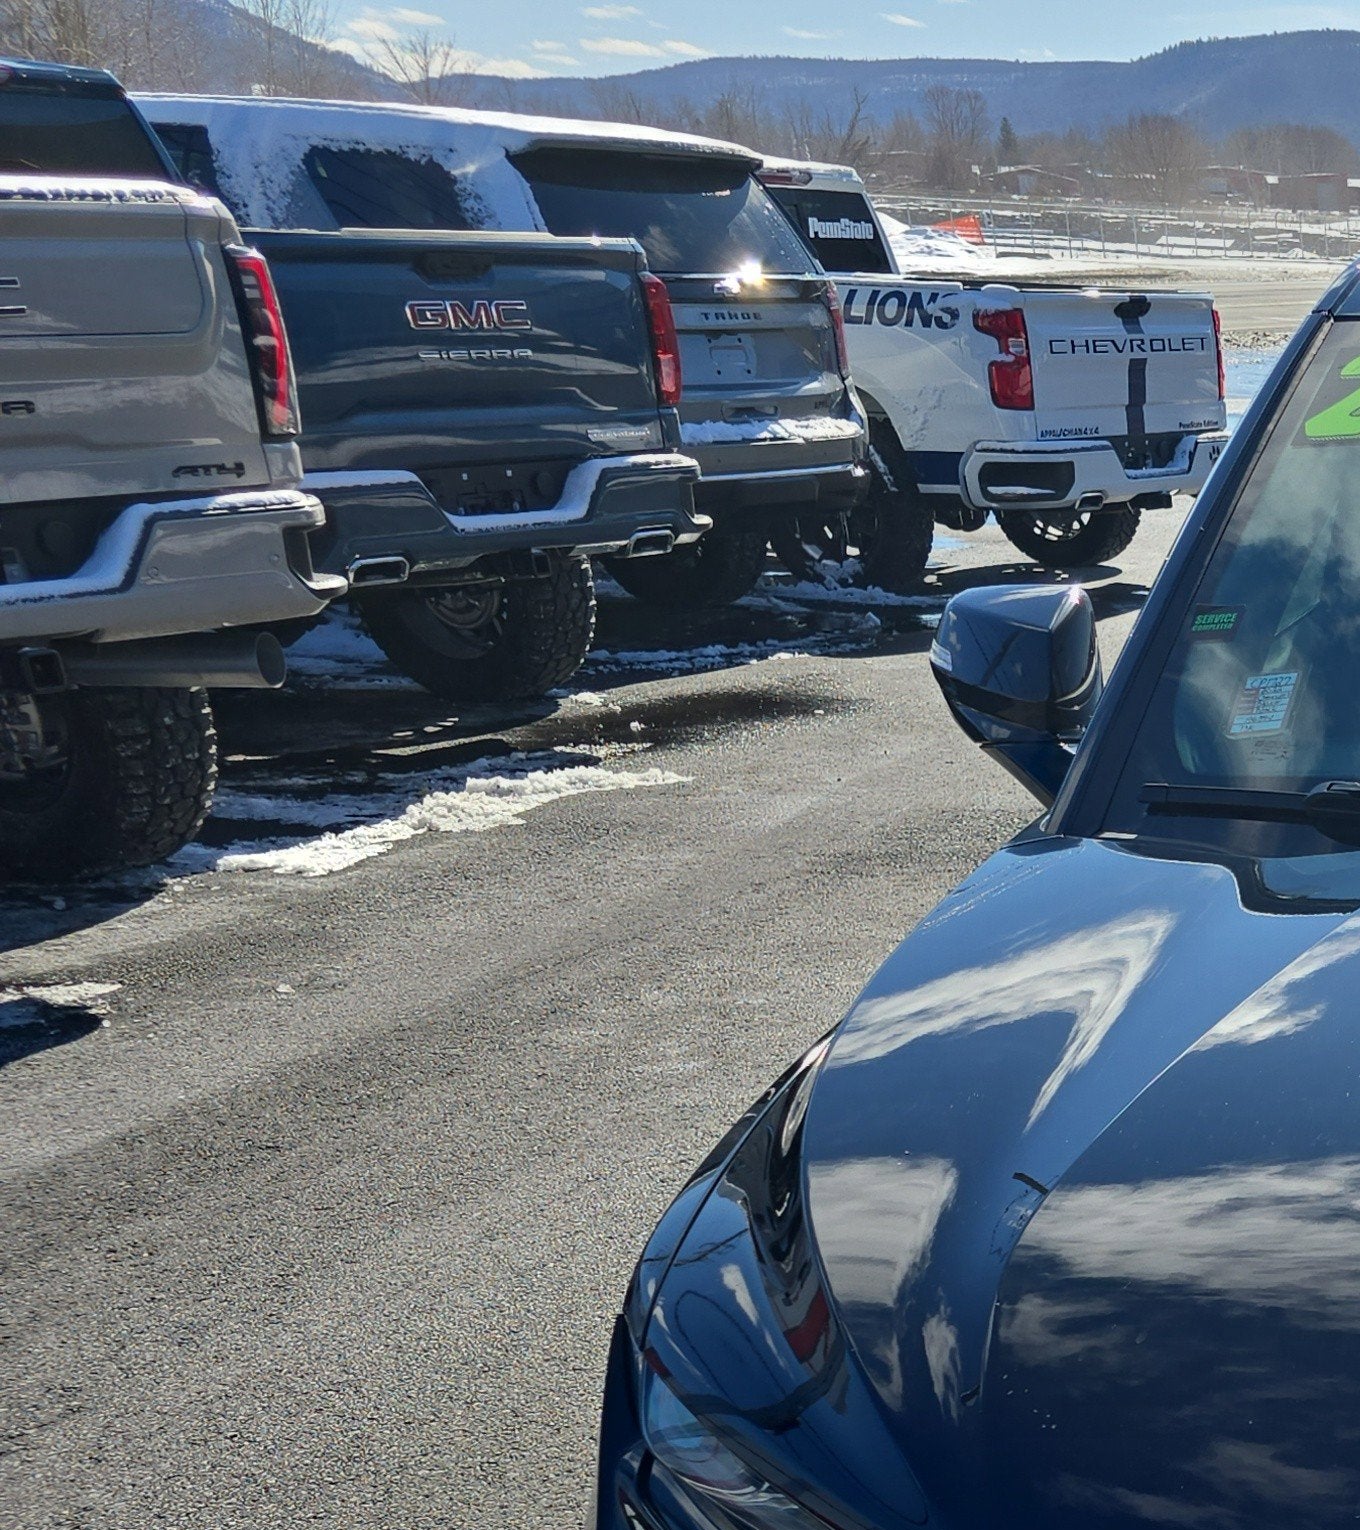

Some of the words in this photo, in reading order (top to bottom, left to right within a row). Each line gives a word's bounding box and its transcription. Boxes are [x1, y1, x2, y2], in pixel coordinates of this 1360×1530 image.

[405, 300, 533, 330] GMC
[700, 310, 763, 322] TAHOE
[843, 288, 960, 330] LIONS
[418, 348, 533, 360] SIERRA
[1049, 336, 1208, 354] CHEVROLET
[171, 461, 246, 479] AT4
[1195, 613, 1238, 625] SERVICE
